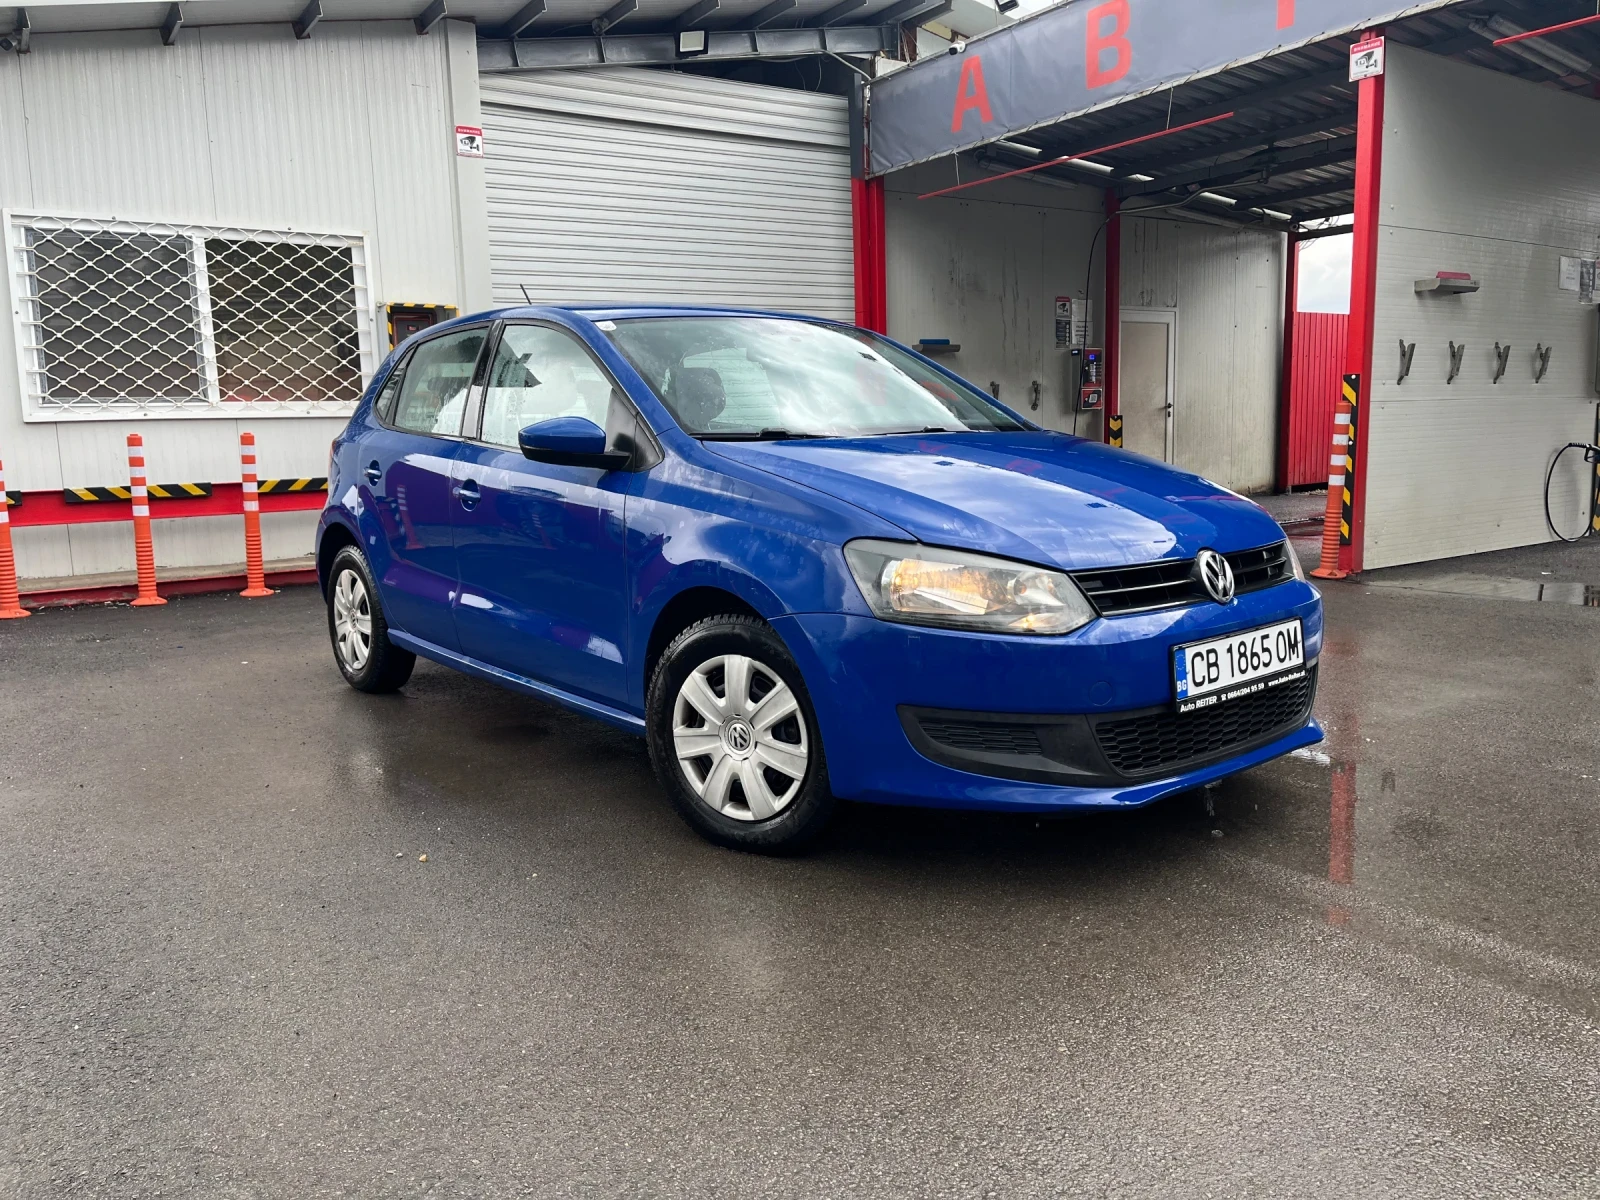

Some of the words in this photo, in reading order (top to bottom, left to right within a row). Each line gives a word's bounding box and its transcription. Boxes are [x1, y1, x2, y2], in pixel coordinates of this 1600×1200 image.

[1191, 647, 1220, 688] CB
[1226, 633, 1272, 678] 1865
[1276, 626, 1299, 663] OM
[1177, 679, 1187, 693] BG
[1180, 702, 1195, 713] Auto
[1195, 696, 1217, 708] REITER
[1250, 684, 1258, 692] 95
